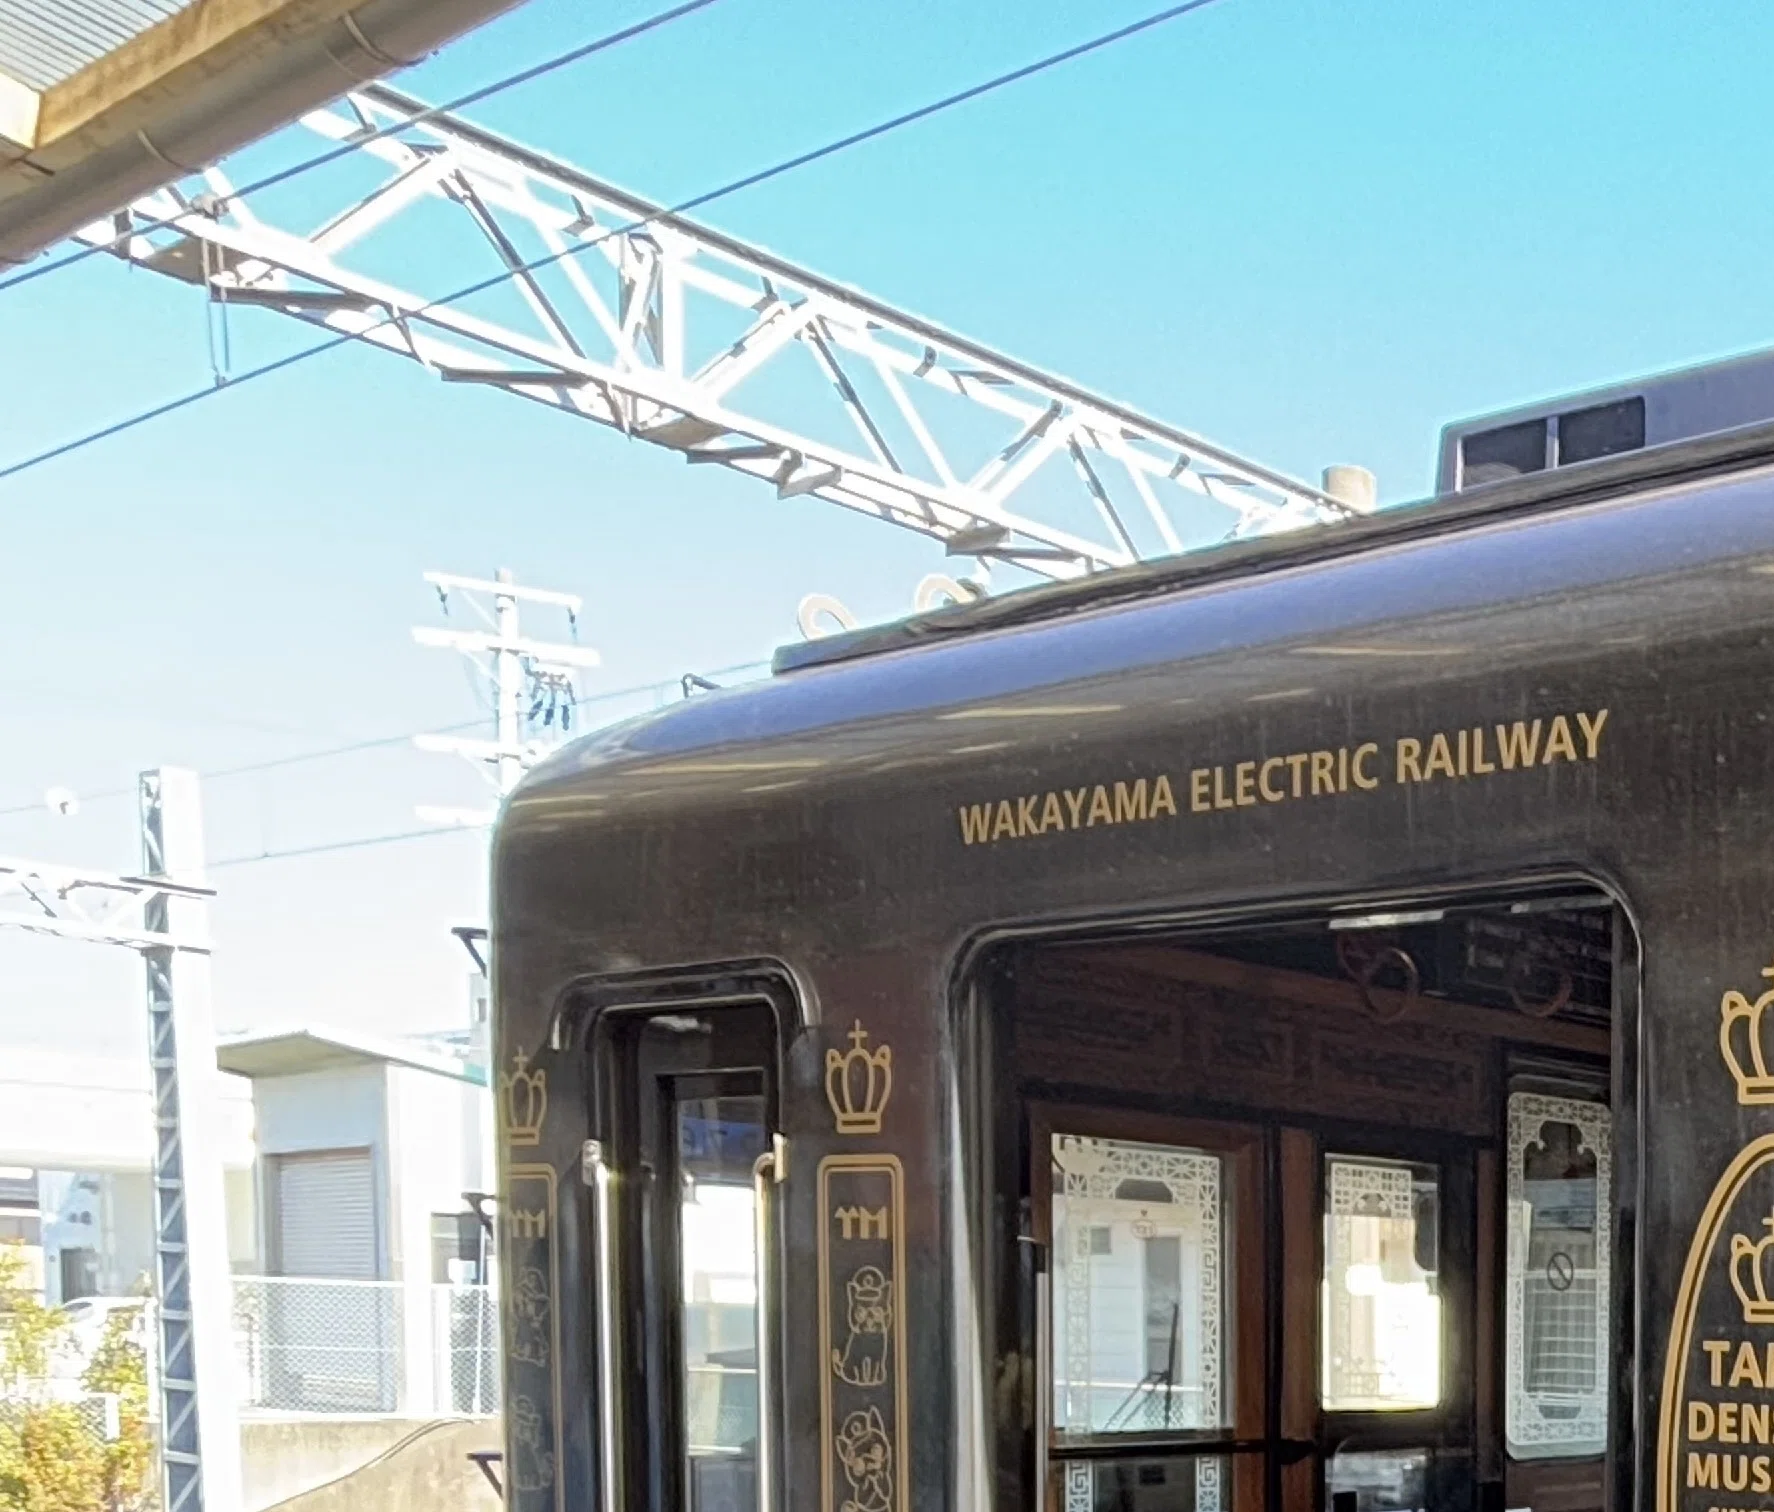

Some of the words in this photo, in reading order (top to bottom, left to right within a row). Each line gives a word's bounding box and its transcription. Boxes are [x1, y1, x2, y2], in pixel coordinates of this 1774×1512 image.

[959, 774, 1176, 845] WAKAYAMA
[1190, 742, 1379, 812] ELECTRIC
[1396, 708, 1609, 784] RAILWAY
